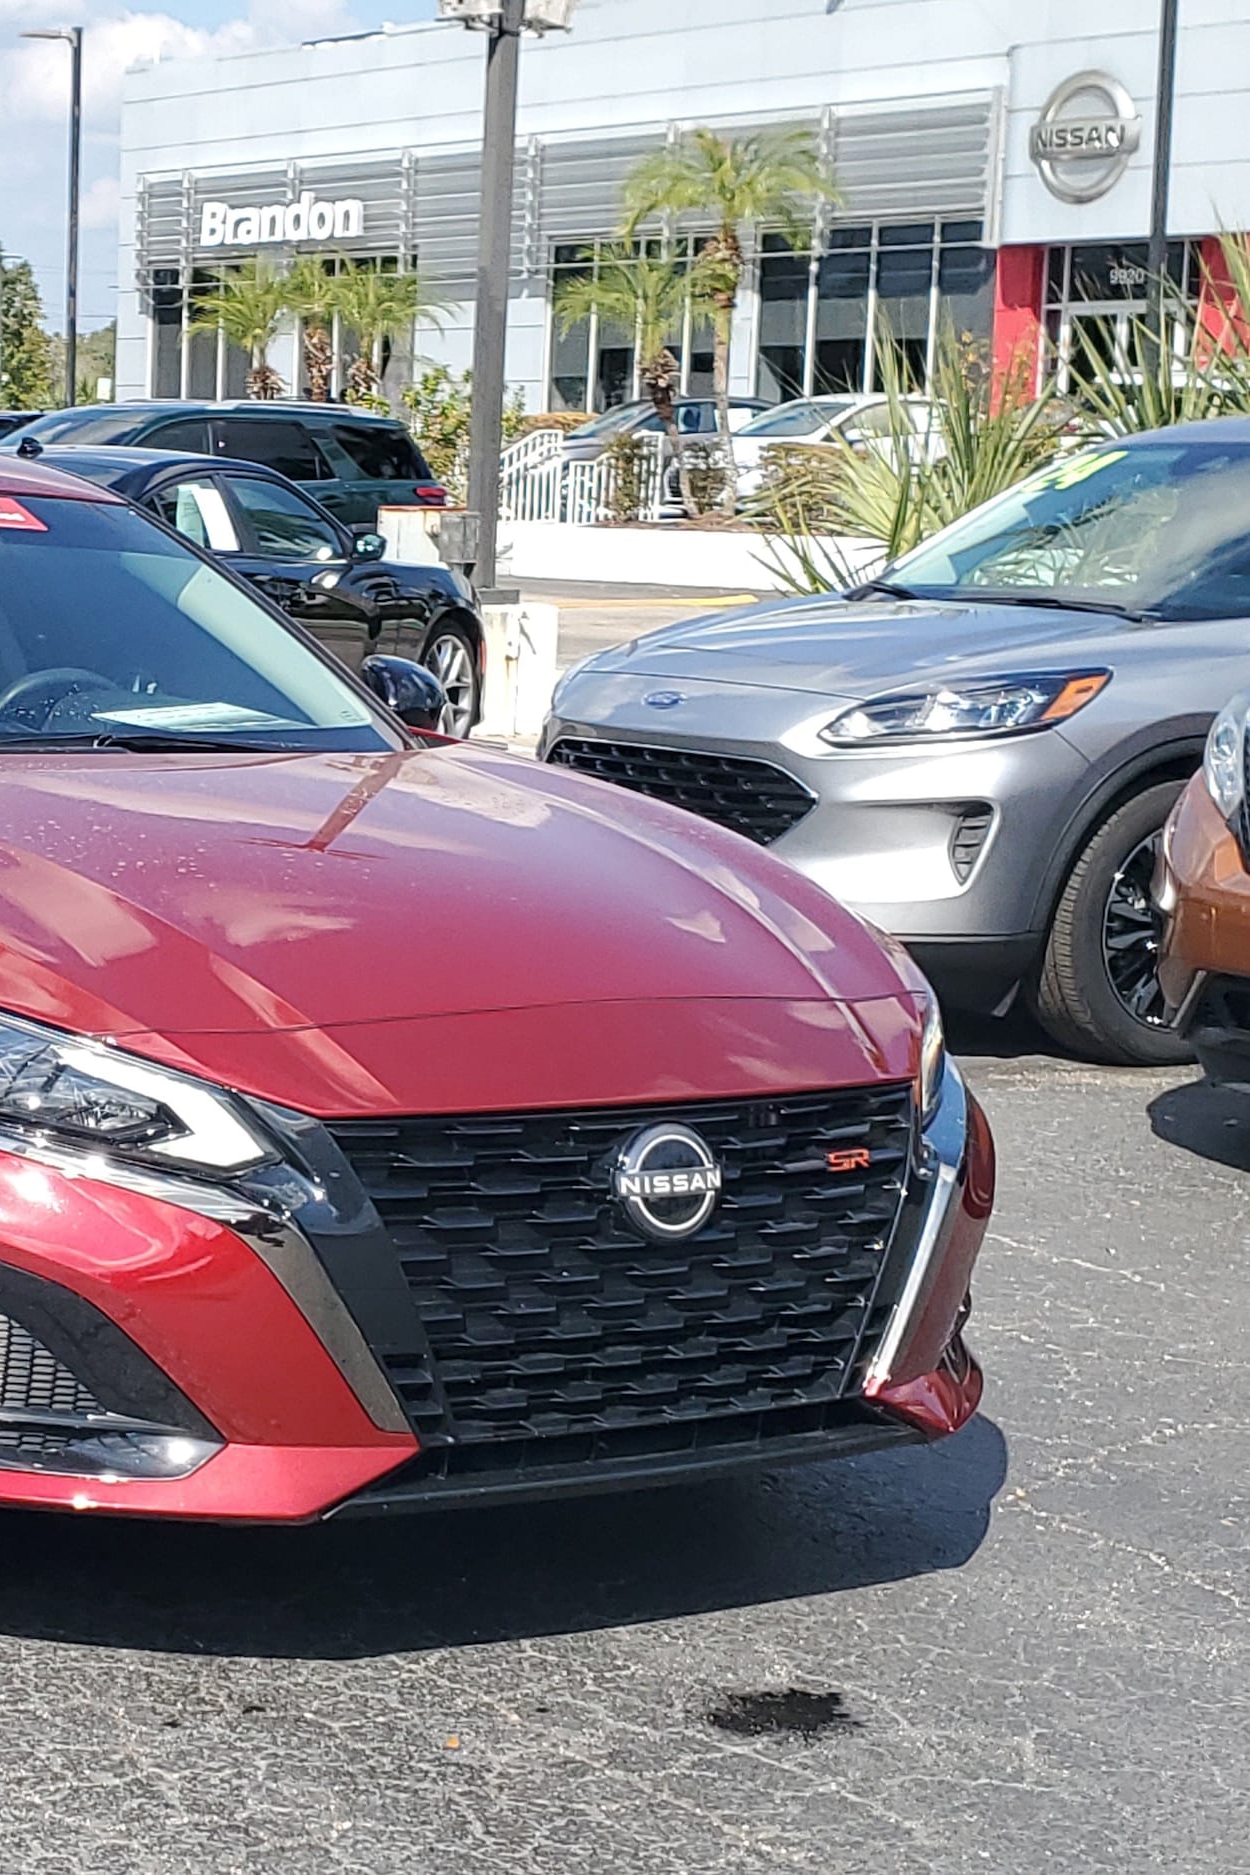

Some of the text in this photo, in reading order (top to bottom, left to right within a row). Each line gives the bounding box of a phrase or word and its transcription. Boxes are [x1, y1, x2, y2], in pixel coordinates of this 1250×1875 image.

[1038, 124, 1125, 148] NISSAN
[200, 191, 364, 246] Brandon
[827, 1149, 870, 1171] SR
[620, 1170, 721, 1194] NISSAN
